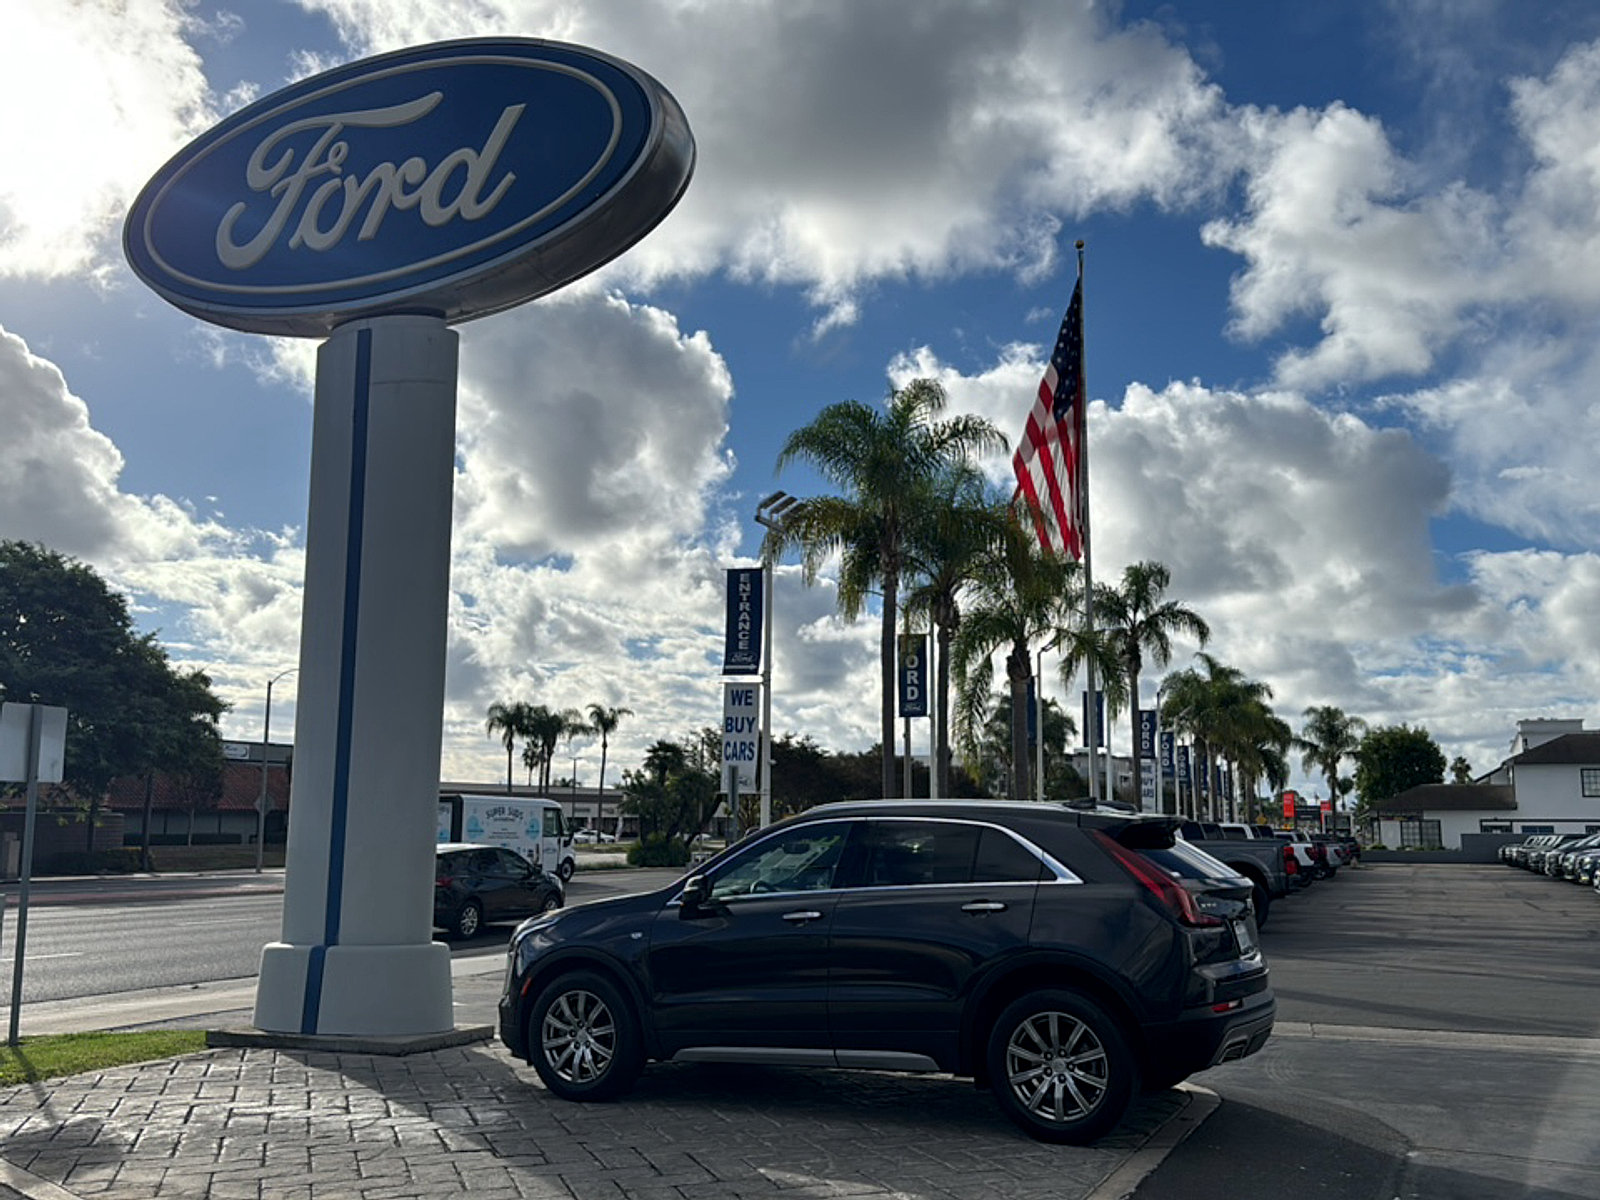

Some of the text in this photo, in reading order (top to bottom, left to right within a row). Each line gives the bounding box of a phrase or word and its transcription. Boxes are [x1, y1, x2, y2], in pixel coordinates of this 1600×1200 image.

[215, 91, 527, 271] Ford
[738, 573, 752, 650] ENTRANCE
[731, 689, 753, 706] WE
[725, 716, 756, 733] BUY
[1142, 712, 1150, 749] FORD
[724, 741, 755, 761] CARS
